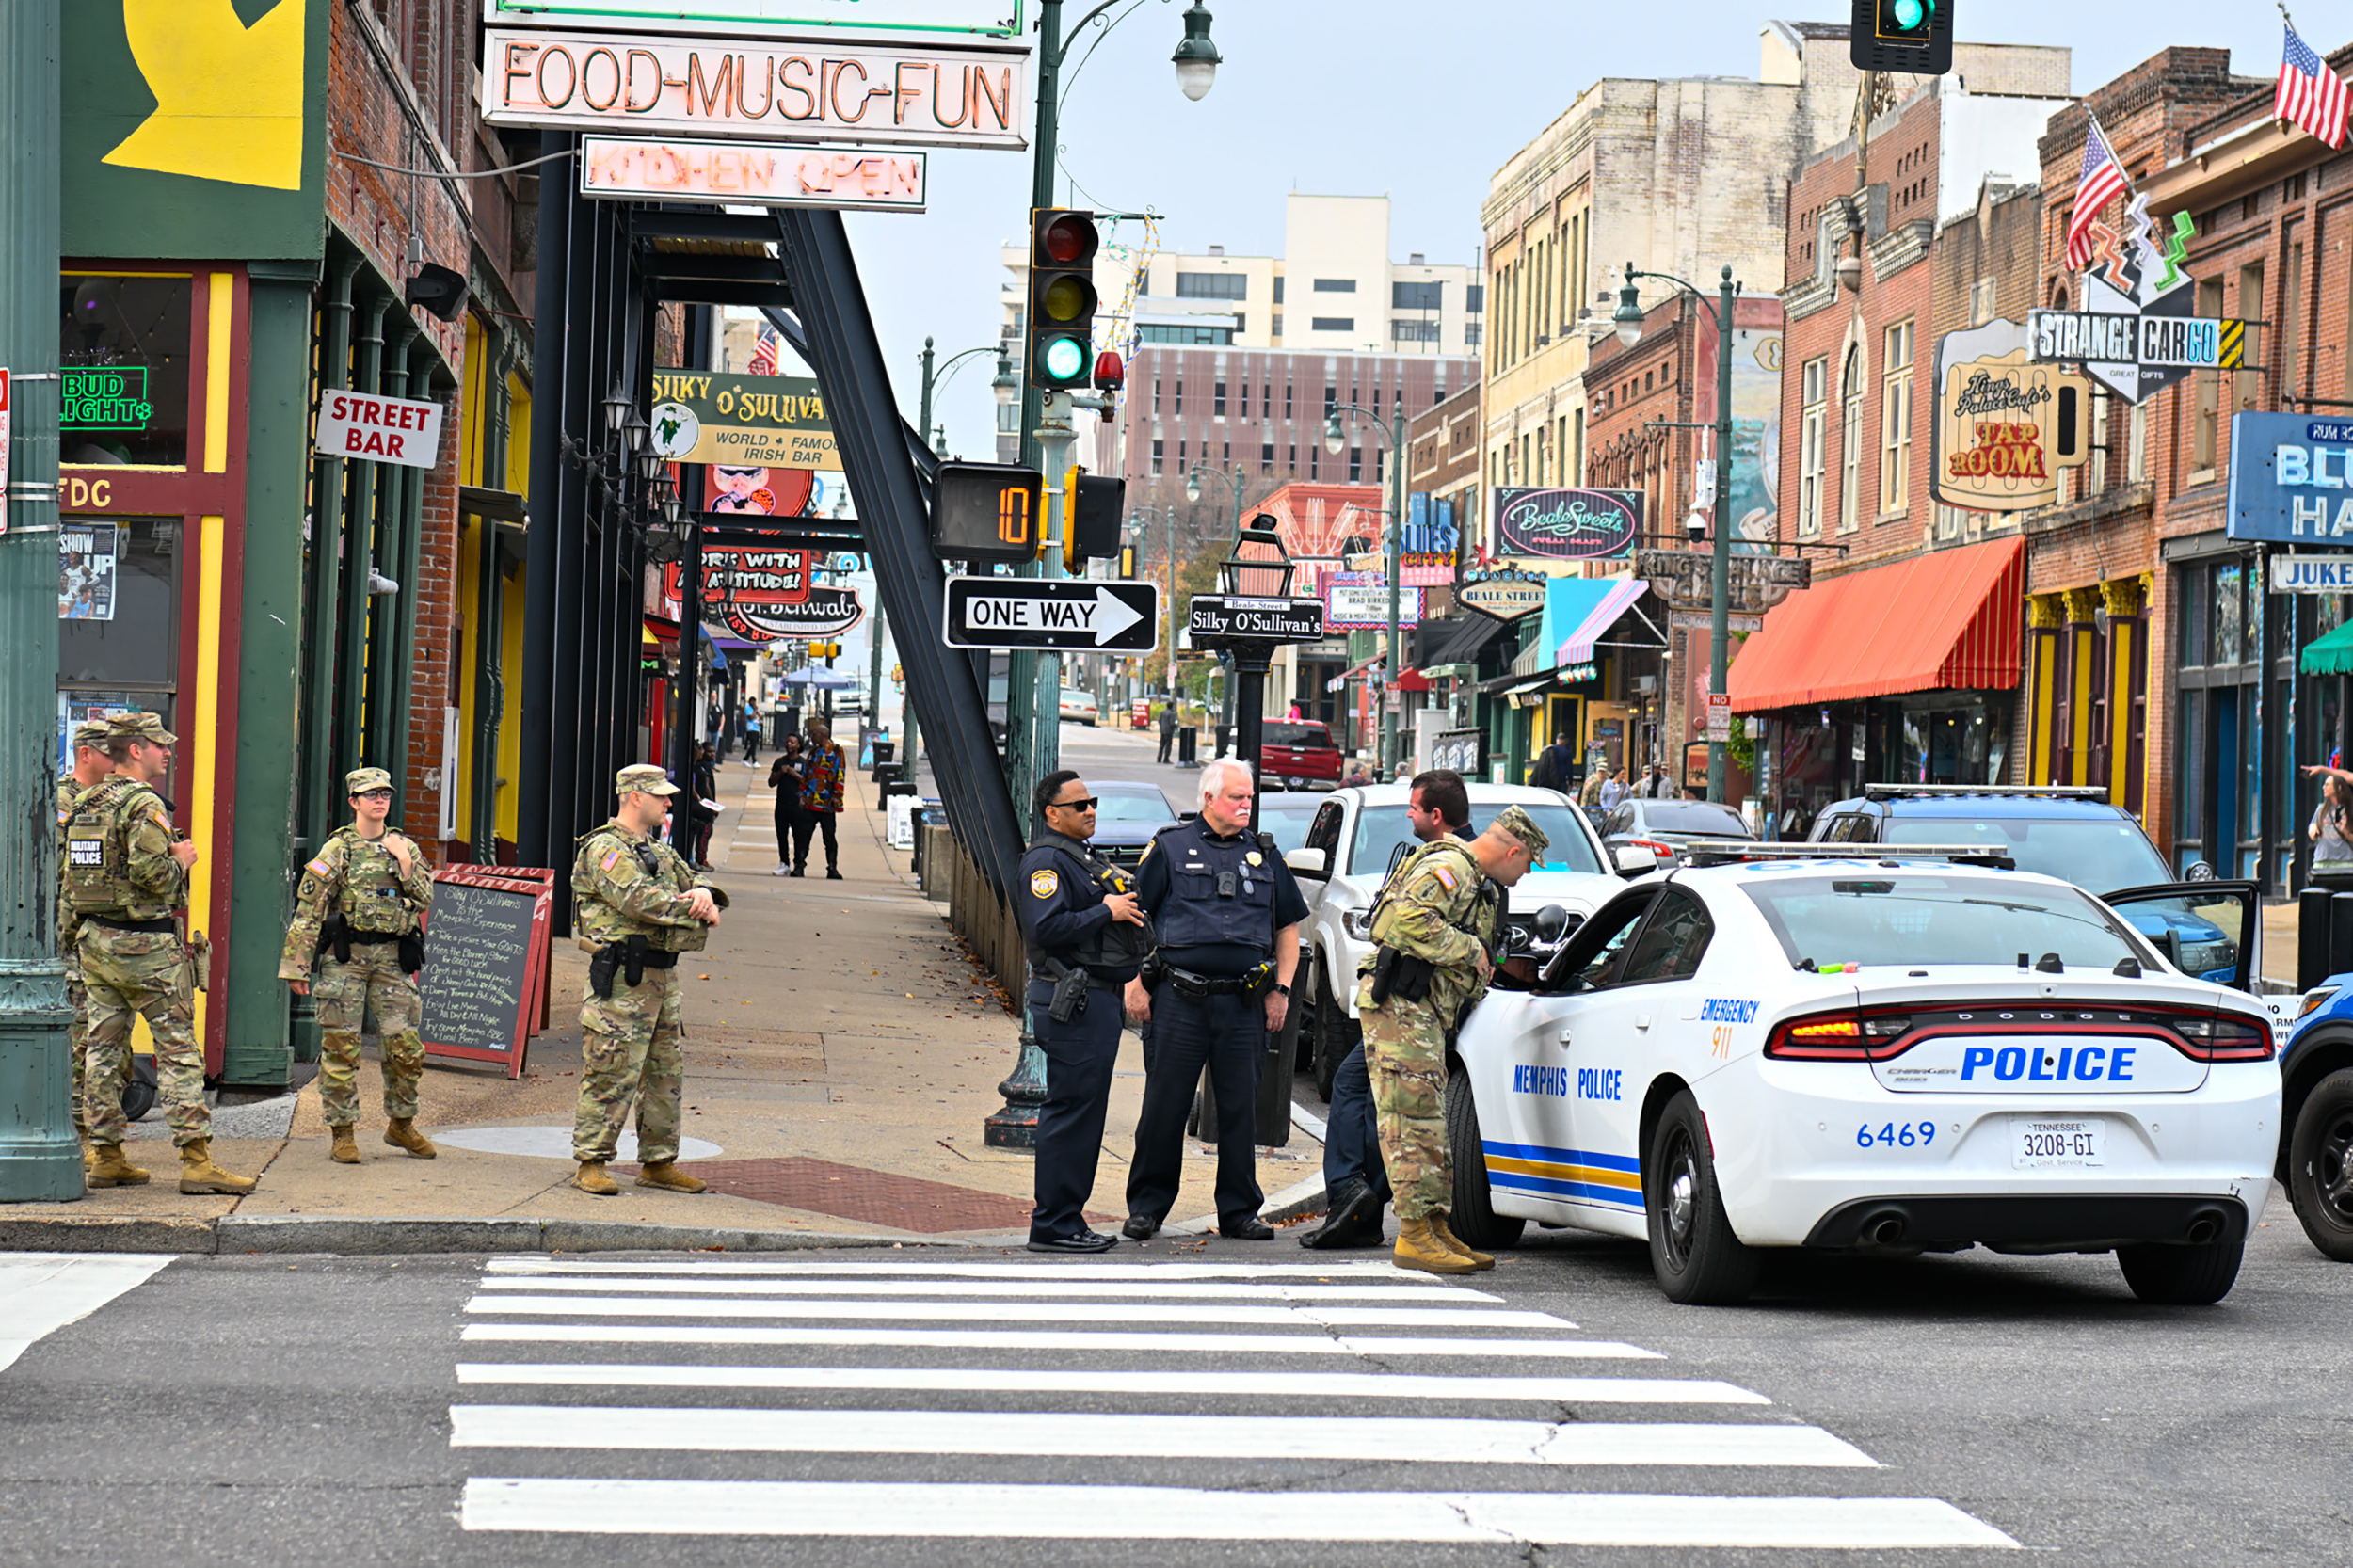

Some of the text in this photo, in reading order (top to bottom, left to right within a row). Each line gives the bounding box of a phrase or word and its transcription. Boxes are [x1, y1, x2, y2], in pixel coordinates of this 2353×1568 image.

[797, 154, 919, 196] OPEN
[2039, 313, 2216, 363] STRANGE CARGO
[2110, 370, 2164, 380] GREAT GIFTS
[62, 375, 124, 398] BUD
[653, 375, 830, 423] SILKY O'SULLIVA
[1954, 395, 2007, 417] Palace
[331, 395, 431, 432] STREET
[716, 432, 840, 452] WORLD FAMOU
[1976, 423, 2039, 447] TAP
[2313, 424, 2338, 440] RUM
[345, 427, 405, 458] BAR
[744, 447, 823, 464] IRISH BAR
[1950, 445, 2047, 477] ROOM
[2276, 444, 2353, 490] BL
[998, 486, 1030, 545] 10
[1510, 501, 1624, 536] Beale Sweets
[59, 533, 94, 554] SHOW
[83, 554, 114, 575] UP
[743, 553, 801, 568] WITH
[1402, 553, 1454, 567] CITY
[708, 571, 803, 590] ATITUDE!
[1400, 568, 1451, 577] GENERAL
[1408, 576, 1444, 584] STORE
[1730, 558, 1801, 583] ALACE
[2285, 562, 2353, 585] JUKE
[1232, 600, 1283, 611] Beale Street
[1466, 591, 1502, 601] BEALE
[973, 600, 1096, 628] ONE WAY
[1193, 611, 1321, 633] Silky O'Sullivan's
[728, 615, 747, 634] 159
[763, 620, 816, 632] ESTABLISHED
[1713, 696, 1728, 705] NO
[71, 840, 101, 851] MILITARY
[71, 851, 102, 865] POLICE
[445, 886, 468, 906] Silky
[437, 930, 452, 941] Take
[450, 947, 461, 956] the
[451, 968, 462, 976] out
[465, 968, 475, 978] the
[425, 998, 446, 1012] Enjoy
[1700, 998, 1760, 1024] EMERGENCY
[2267, 1003, 2281, 1015] O
[423, 1017, 439, 1034] Try
[1958, 1012, 2133, 1021] DODGE
[1711, 1025, 1733, 1060] 911
[1961, 1046, 2137, 1081] POLICE
[1513, 1064, 1623, 1101] MEMPHIS POLICE
[1856, 1121, 1936, 1149] 6469
[2033, 1123, 2082, 1132] TENNESSEE
[2024, 1133, 2095, 1157] 3208-GI
[2057, 1159, 2084, 1167] Service
